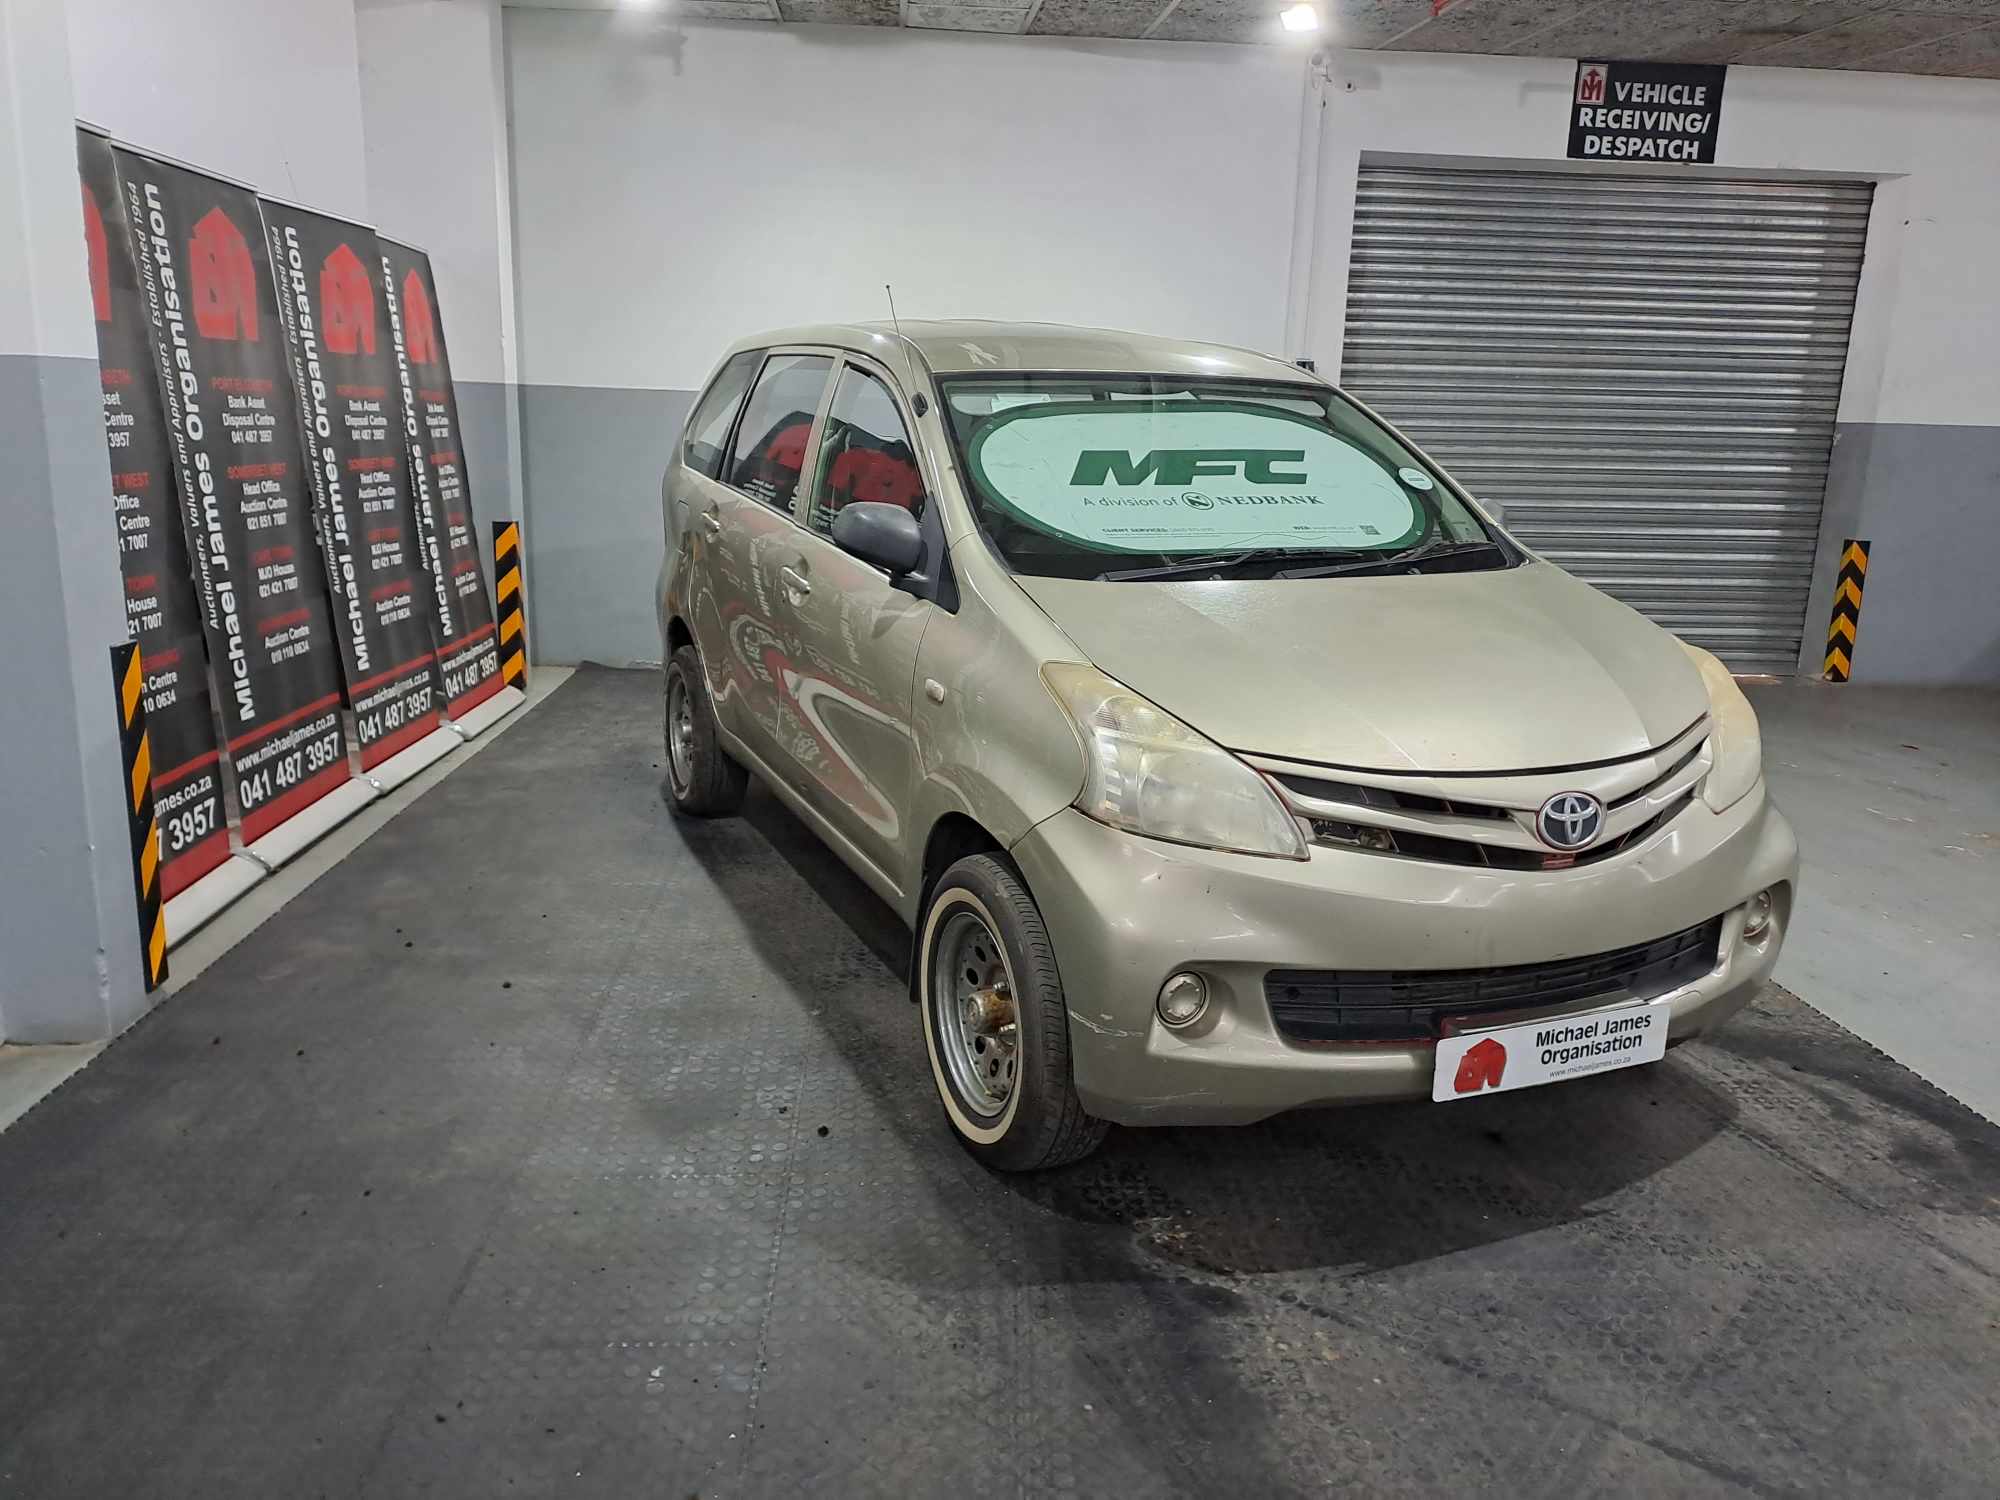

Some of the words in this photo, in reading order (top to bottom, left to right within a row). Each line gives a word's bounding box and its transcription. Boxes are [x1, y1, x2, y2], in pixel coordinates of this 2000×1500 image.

[1614, 81, 1707, 106] VEHICLE
[1579, 107, 1711, 134] RECEIVING/
[1584, 135, 1700, 160] DESPATCH
[127, 181, 144, 224] 1964
[135, 228, 162, 327] Established
[144, 183, 203, 441] Organisation
[285, 226, 331, 438] Organisation
[381, 256, 418, 437] Organisation
[103, 391, 121, 406] sset
[158, 342, 182, 430] Appraisers
[104, 412, 134, 427] Centre
[108, 432, 130, 447] 3957
[174, 432, 188, 465] and
[306, 429, 318, 458] and
[412, 444, 434, 528] James
[1069, 449, 1308, 486] MFC
[182, 468, 200, 528] Valuers
[194, 452, 229, 571] James
[323, 447, 350, 546] James
[1083, 497, 1096, 506] A
[1099, 496, 1160, 506] division
[1163, 496, 1178, 506] of
[1215, 495, 1326, 505] NEDBANK
[119, 514, 151, 531] Centre
[127, 533, 148, 550] 7007
[127, 596, 158, 614] House
[426, 536, 453, 636] Michael
[141, 612, 163, 630] 7007
[338, 554, 371, 671] Michael
[215, 581, 256, 721] Michael
[148, 671, 178, 691] Centre
[445, 675, 465, 699] 041
[464, 661, 478, 688] 487
[479, 651, 498, 679] 3957
[358, 712, 382, 743] 041
[384, 698, 406, 730] 487
[406, 686, 432, 718] 3957
[235, 712, 336, 773] www.michaeljames.co.za
[240, 768, 272, 809] 041
[275, 752, 303, 789] 487
[305, 731, 339, 772] 3957
[168, 797, 216, 850] 3957
[1536, 1021, 1599, 1048] Michael
[1602, 1014, 1652, 1036] James
[1541, 1034, 1643, 1065] Organisation
